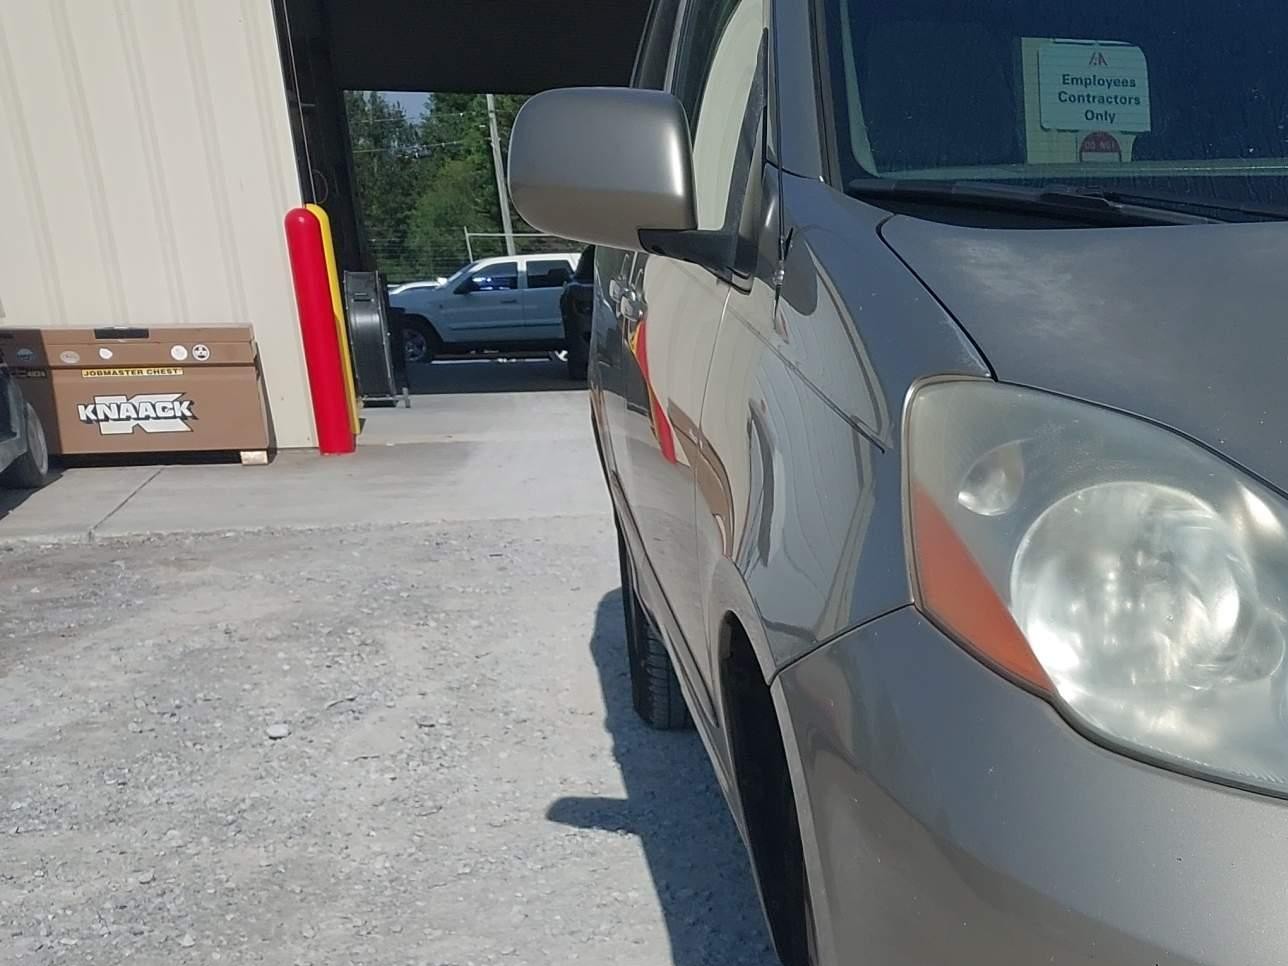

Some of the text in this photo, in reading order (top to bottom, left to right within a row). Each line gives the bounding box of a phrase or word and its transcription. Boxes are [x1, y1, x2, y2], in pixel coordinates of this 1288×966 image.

[1061, 73, 1137, 89] Employees
[1057, 90, 1141, 105] Contractors
[1084, 109, 1117, 124] Only
[83, 368, 178, 377] JOBMASTER CHEST
[77, 400, 194, 422] KNAACK
